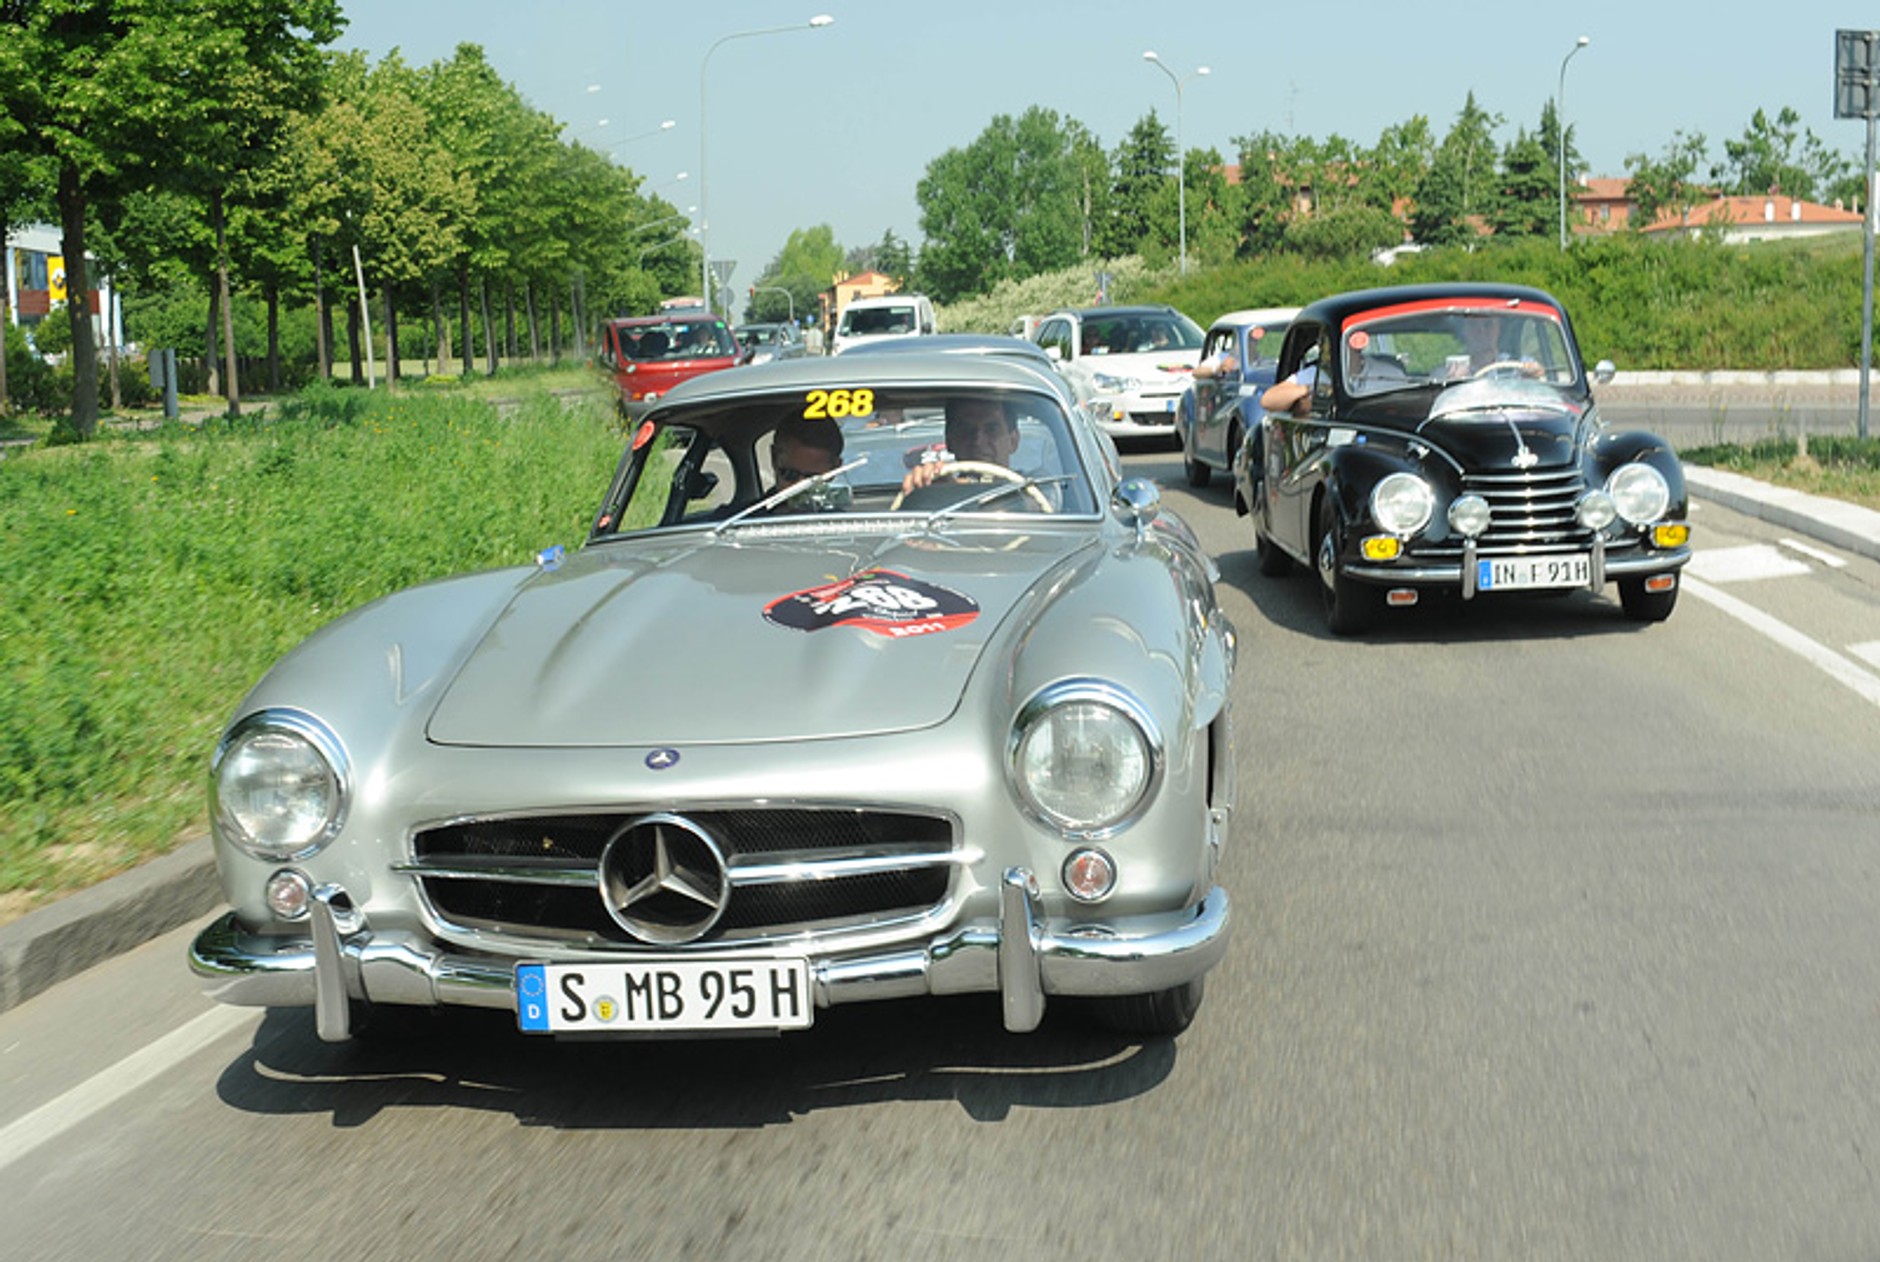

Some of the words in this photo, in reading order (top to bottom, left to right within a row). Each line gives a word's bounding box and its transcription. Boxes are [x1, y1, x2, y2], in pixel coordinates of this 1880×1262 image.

[803, 388, 875, 419] 268
[1494, 564, 1515, 585] IN
[560, 973, 587, 1022] S
[625, 972, 684, 1021] MB
[528, 1004, 540, 1019] D
